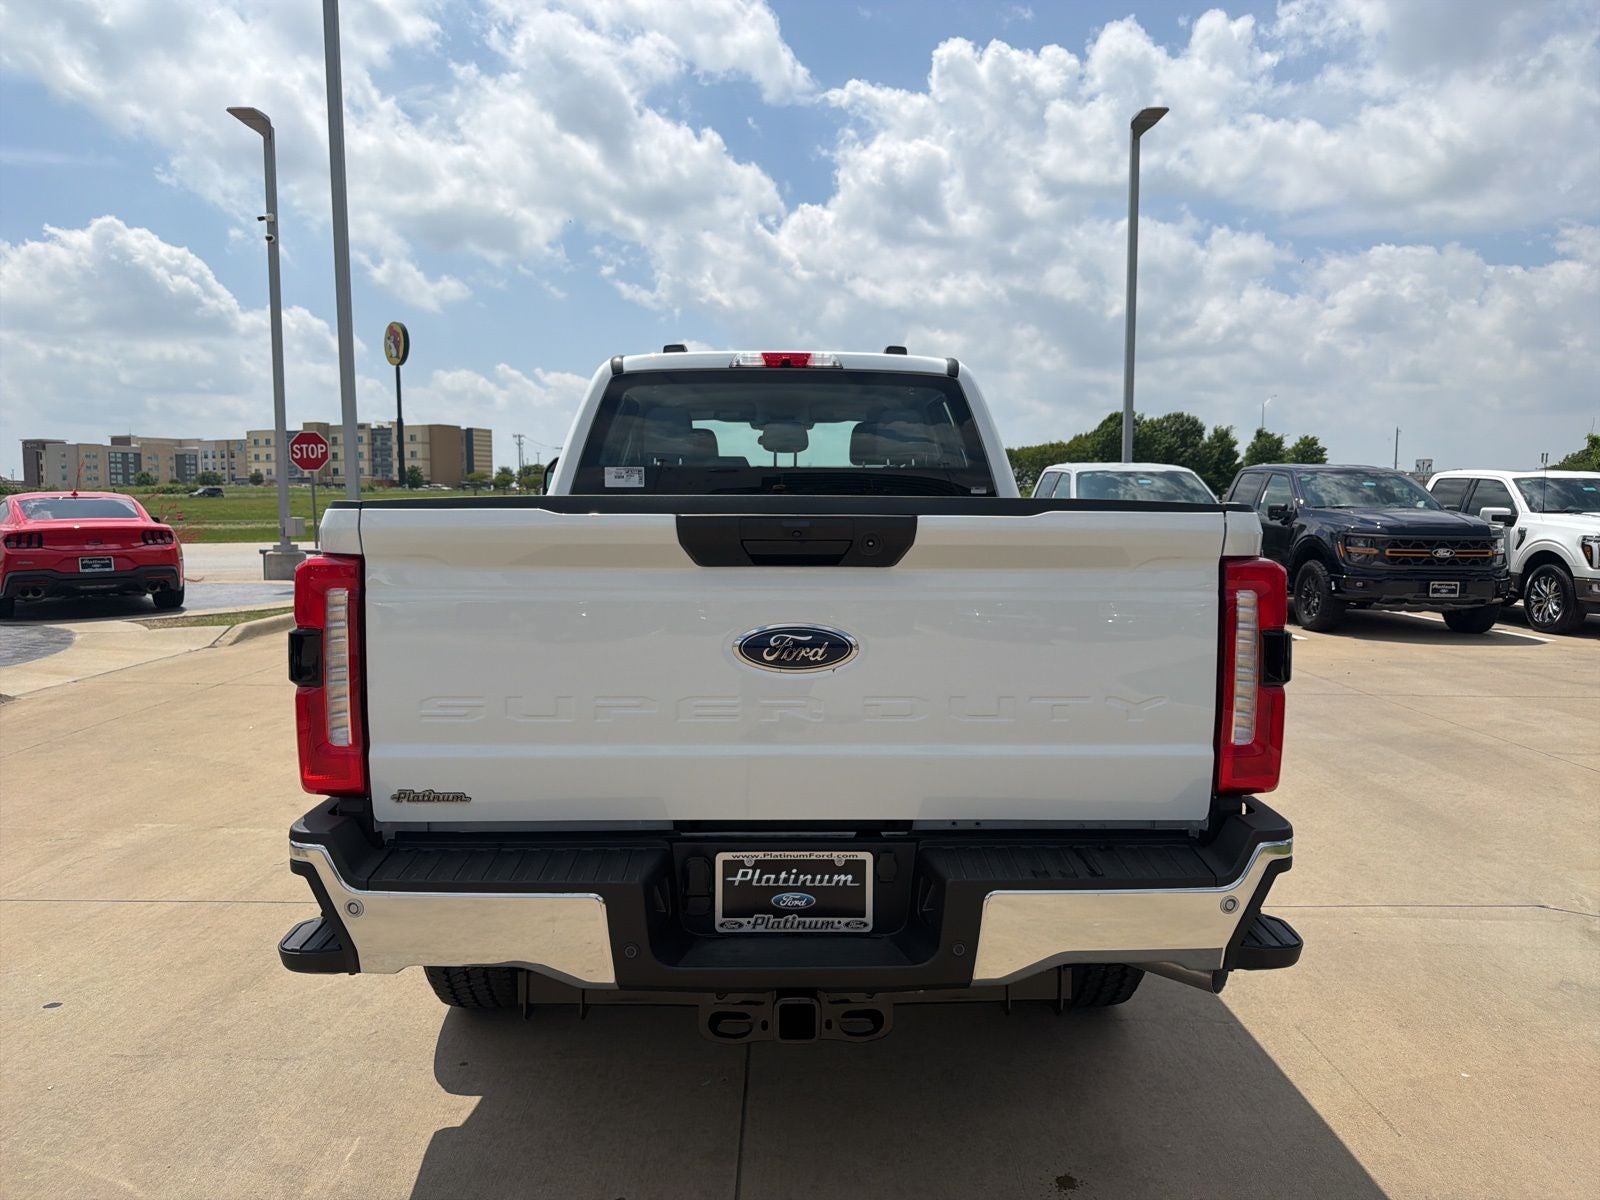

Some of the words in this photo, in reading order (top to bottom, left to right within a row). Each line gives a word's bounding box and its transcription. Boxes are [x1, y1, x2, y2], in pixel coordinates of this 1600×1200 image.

[292, 444, 326, 459] STOP
[763, 634, 828, 661] Ford
[418, 695, 825, 722] SUPER
[864, 695, 1168, 722] DUTY
[391, 789, 472, 803] Platinum
[726, 868, 860, 886] Platinum
[779, 894, 808, 907] Ford
[751, 915, 843, 930] Platinum
